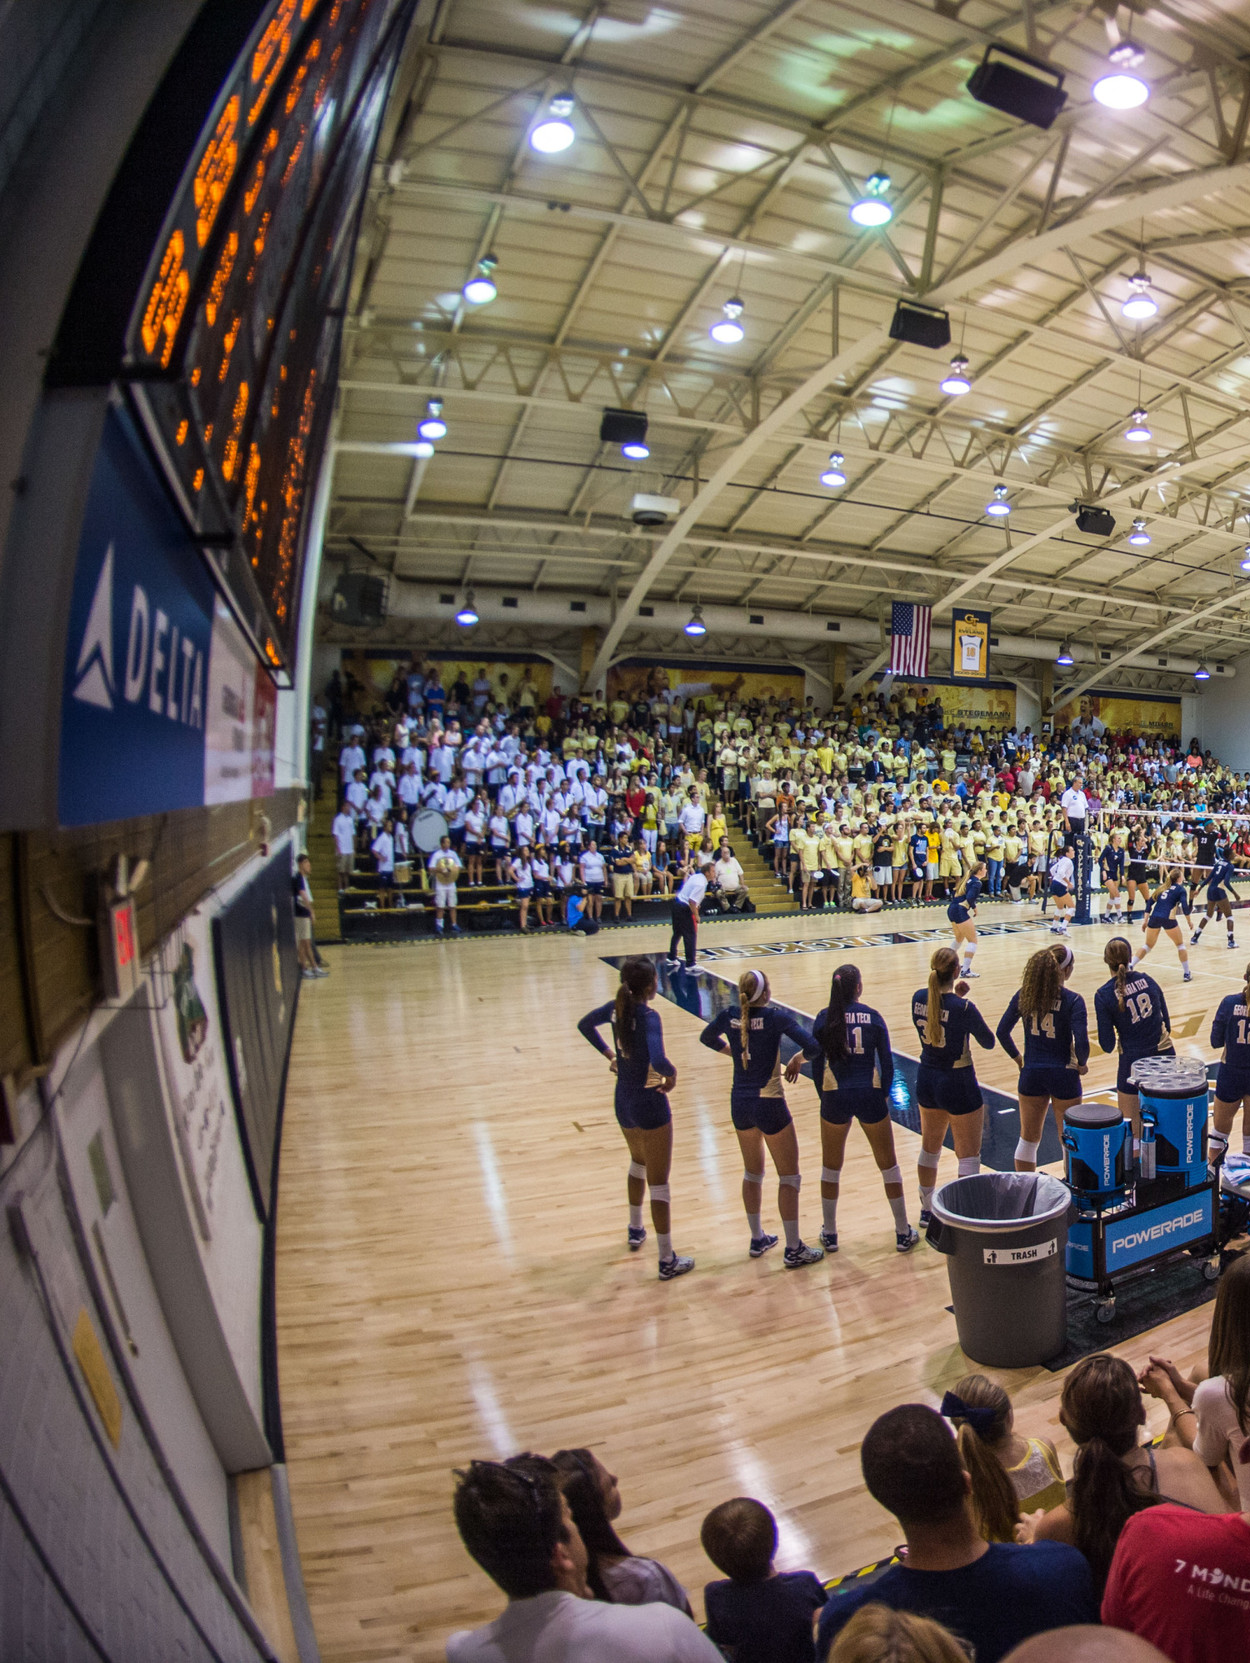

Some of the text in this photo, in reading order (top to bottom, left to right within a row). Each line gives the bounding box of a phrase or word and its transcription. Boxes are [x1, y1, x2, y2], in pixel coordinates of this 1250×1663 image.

[124, 584, 203, 729] DELTA
[958, 710, 1011, 718] STEGEMANN
[1161, 890, 1170, 899] 5
[1135, 978, 1148, 991] TECH
[1126, 993, 1153, 1024] 18
[856, 1013, 871, 1024] TECH
[941, 1010, 950, 1022] CH
[1030, 1011, 1056, 1038] 14
[1112, 1208, 1203, 1253] POWERADE
[1011, 1250, 1037, 1260] TRASH
[1174, 1559, 1186, 1573] 7
[1187, 1585, 1194, 1594] A
[1197, 1587, 1215, 1601] Life
